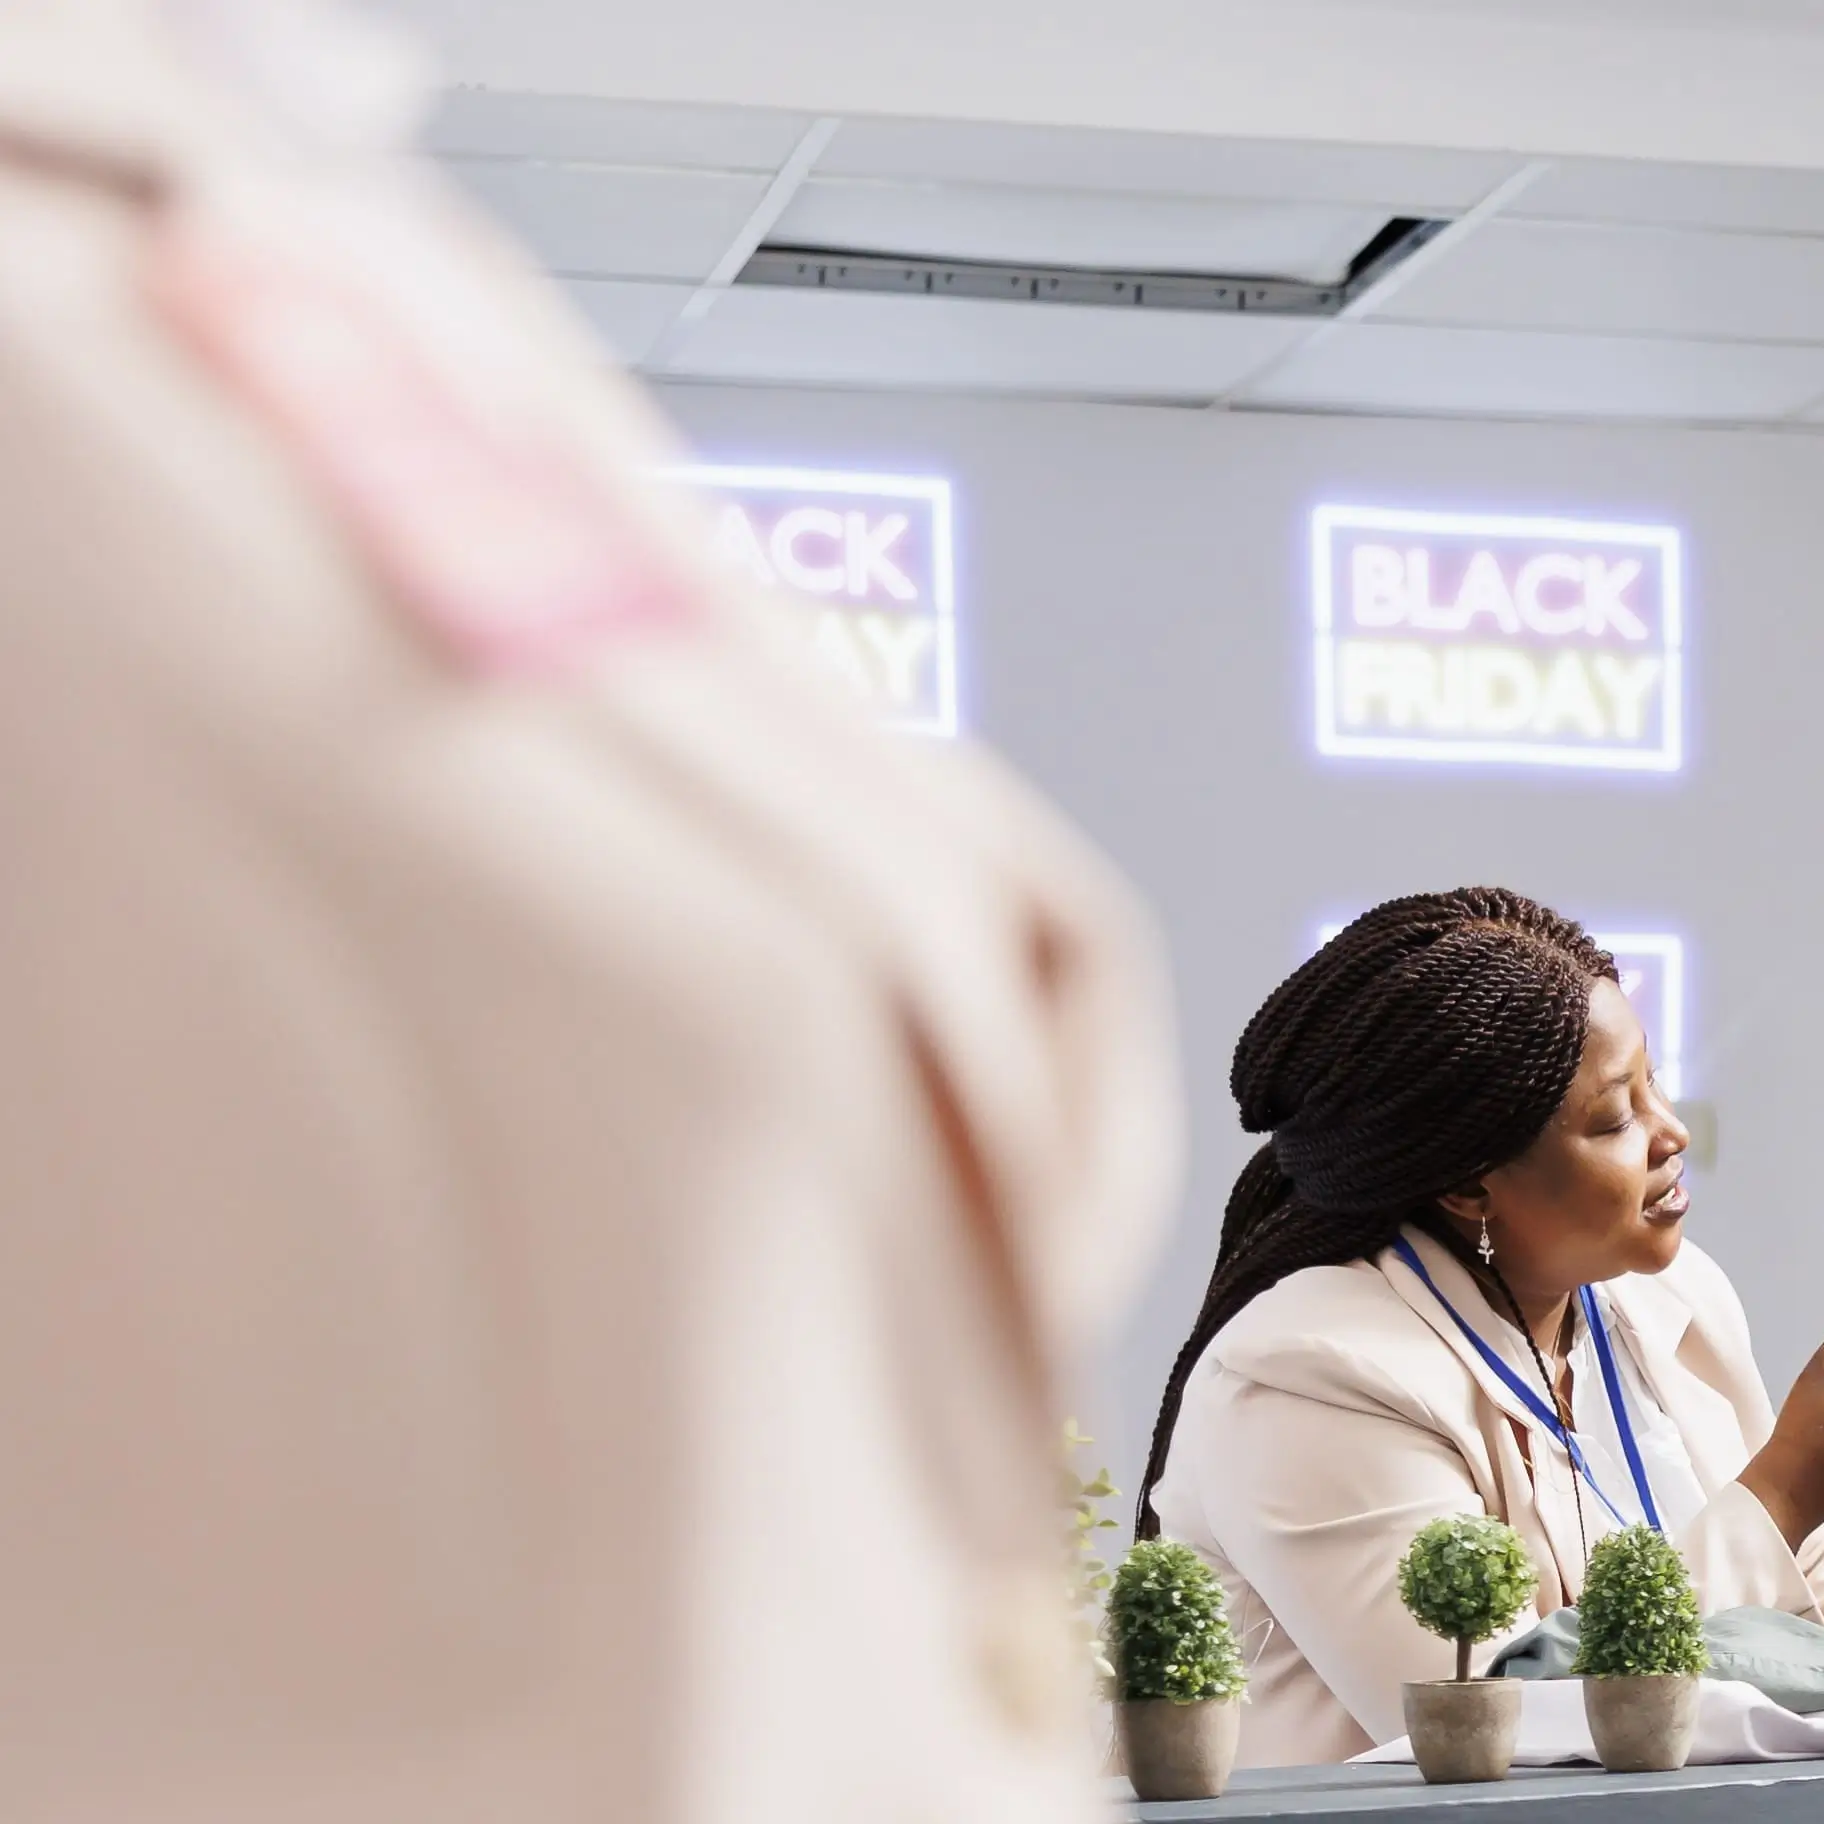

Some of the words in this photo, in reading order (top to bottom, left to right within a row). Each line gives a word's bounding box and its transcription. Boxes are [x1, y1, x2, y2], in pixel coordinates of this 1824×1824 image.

[708, 504, 920, 601] ACK
[1351, 544, 1649, 641] BLACK
[1340, 640, 1664, 740] FRIDAY
